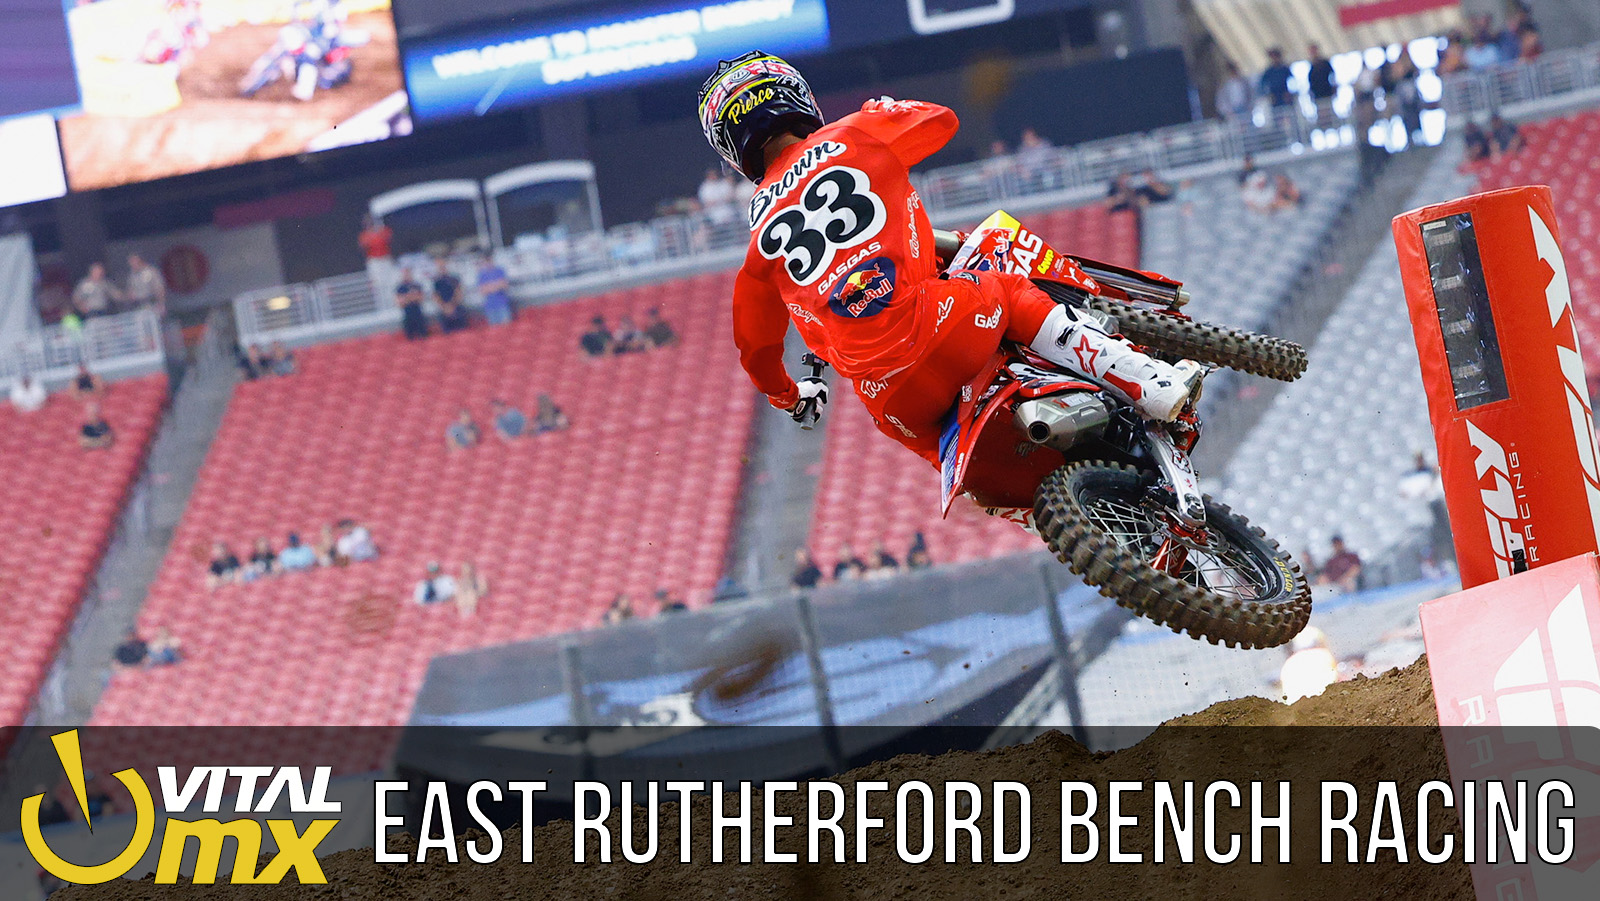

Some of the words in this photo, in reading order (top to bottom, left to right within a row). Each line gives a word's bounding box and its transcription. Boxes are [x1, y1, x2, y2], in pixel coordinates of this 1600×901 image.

[728, 87, 776, 124] Pierce
[748, 140, 842, 229] Brown
[761, 170, 876, 282] 33
[817, 241, 882, 295] GASGAS
[1465, 418, 1528, 579] FLY
[1509, 451, 1540, 562] RACING
